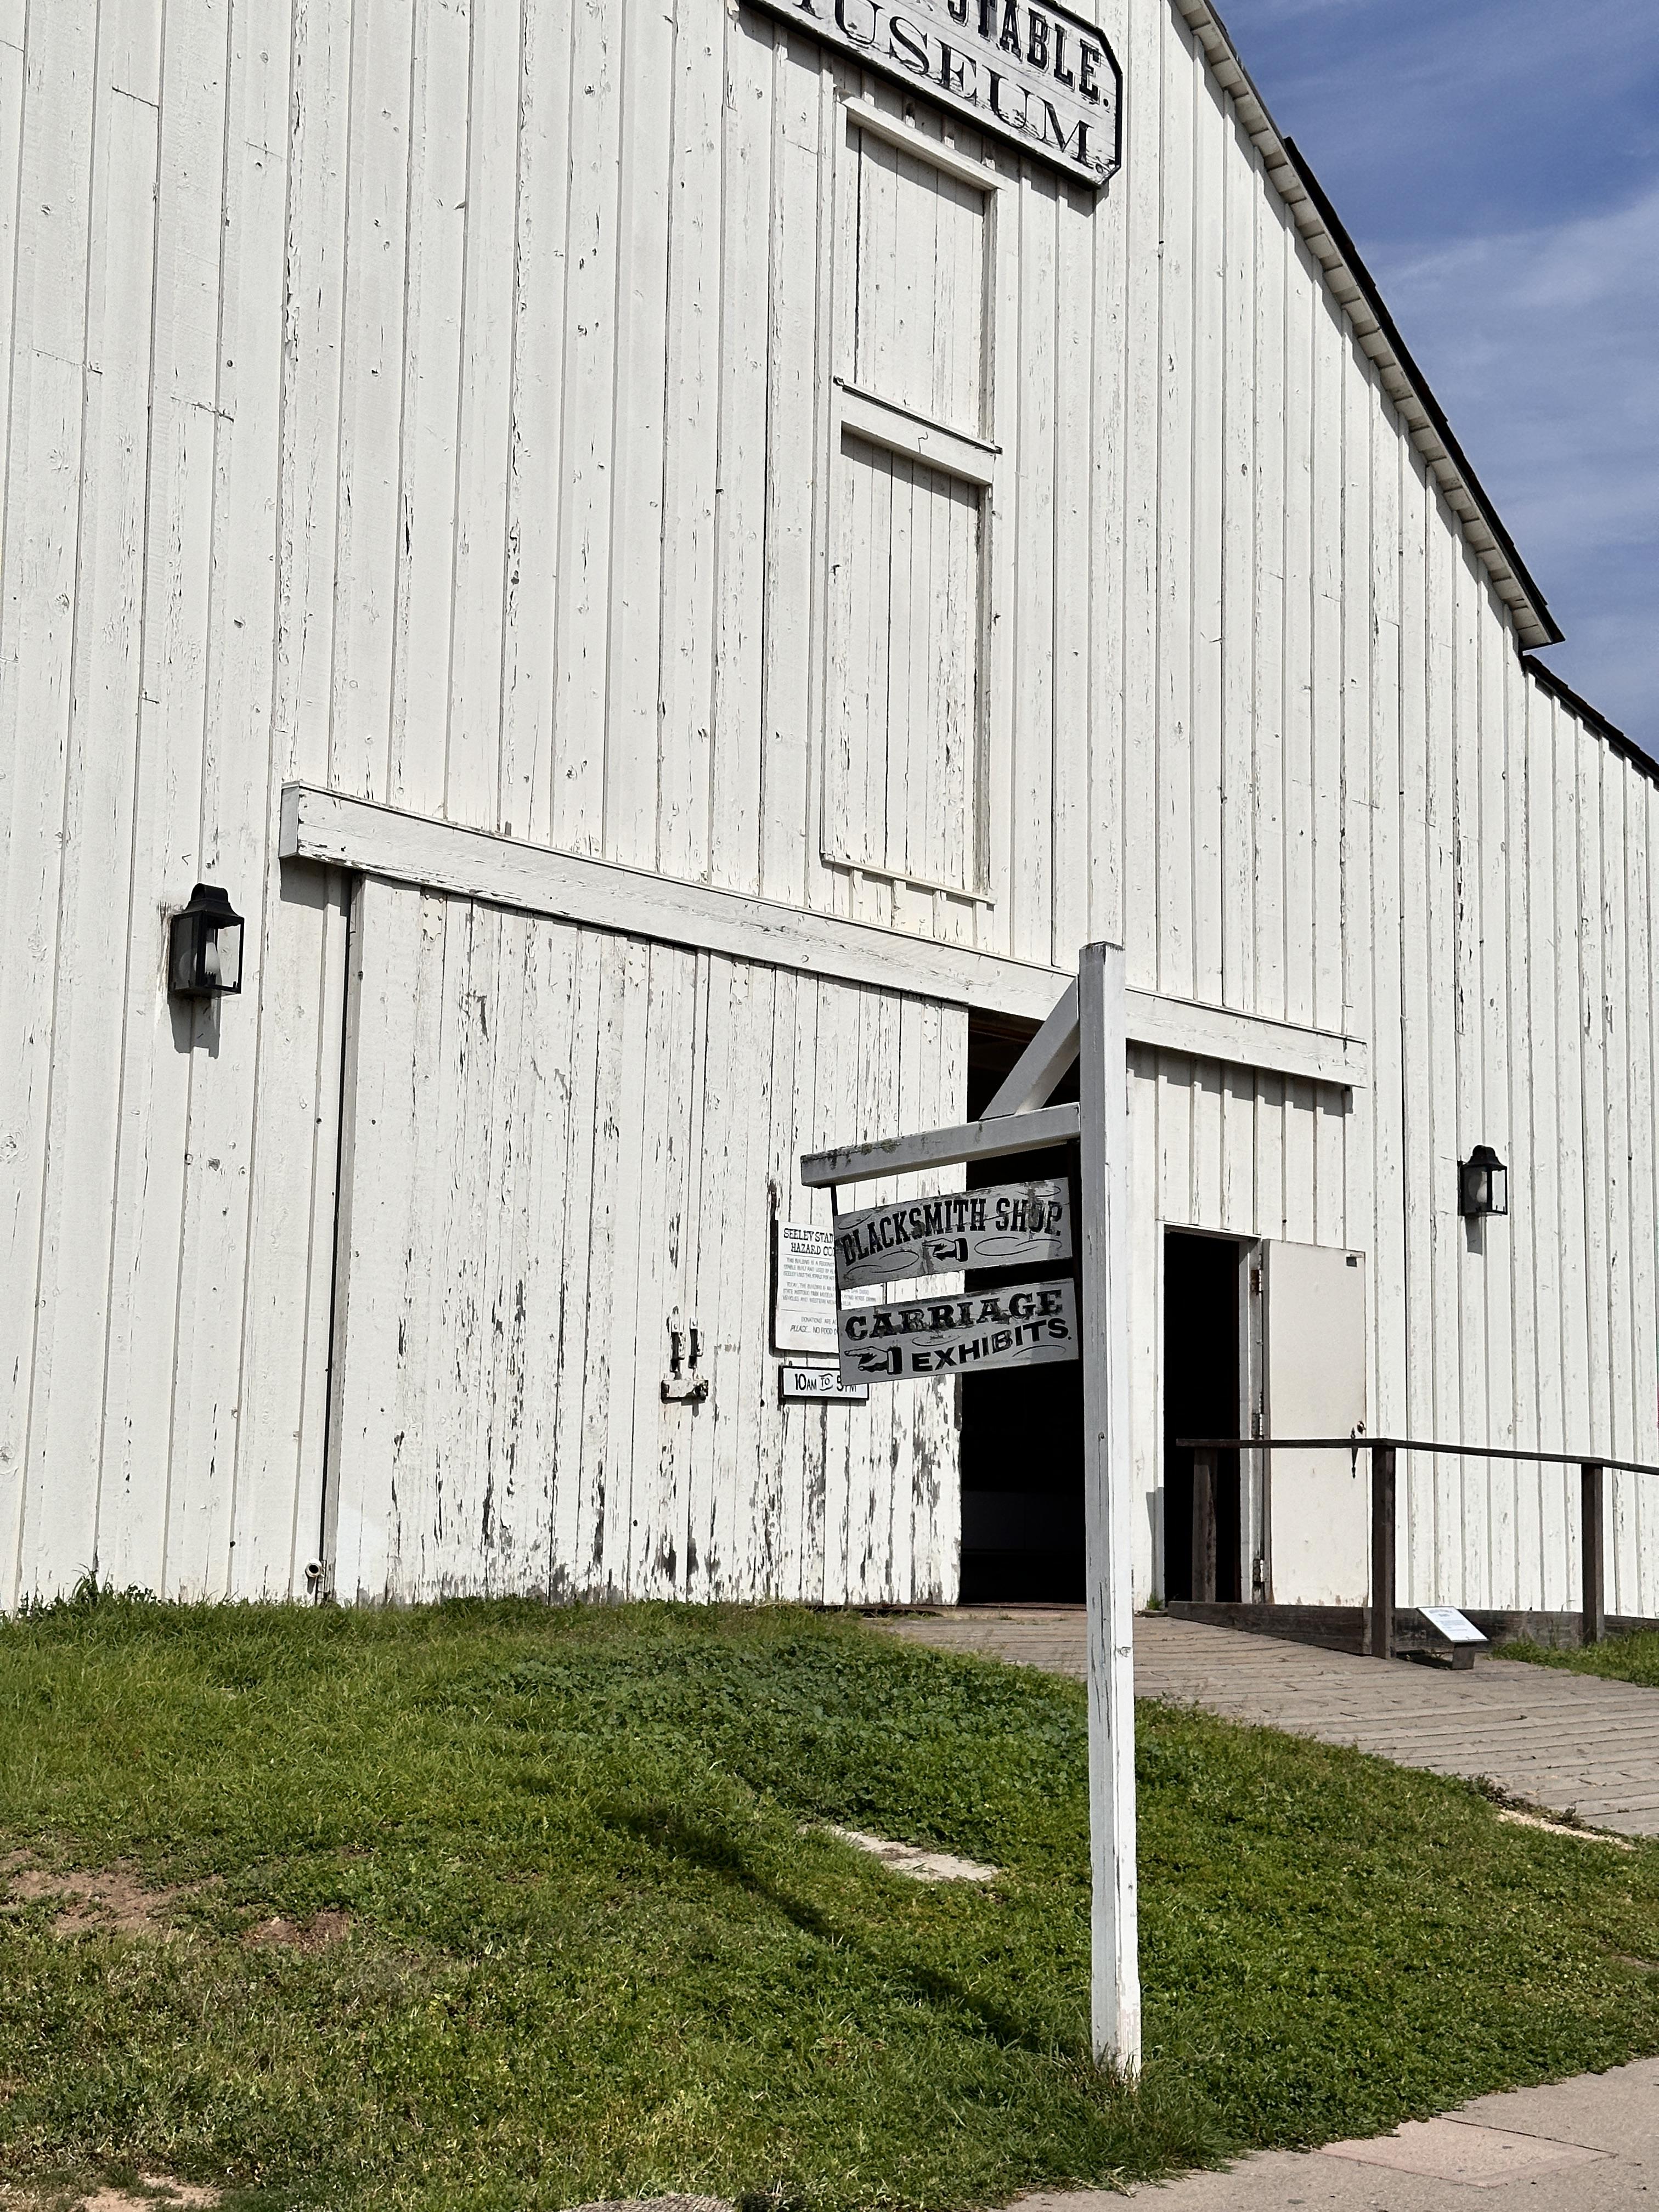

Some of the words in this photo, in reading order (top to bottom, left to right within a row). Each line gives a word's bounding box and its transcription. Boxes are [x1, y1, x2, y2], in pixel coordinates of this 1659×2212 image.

[793, 0, 1094, 170] USEUM
[783, 1228, 815, 1241] SEELEY
[791, 1242, 821, 1255] HAZARD
[840, 1198, 986, 1266] BLACKSMITH
[844, 1289, 1063, 1341] CARRIAGE
[912, 1318, 1073, 1372] EXHIBITS.
